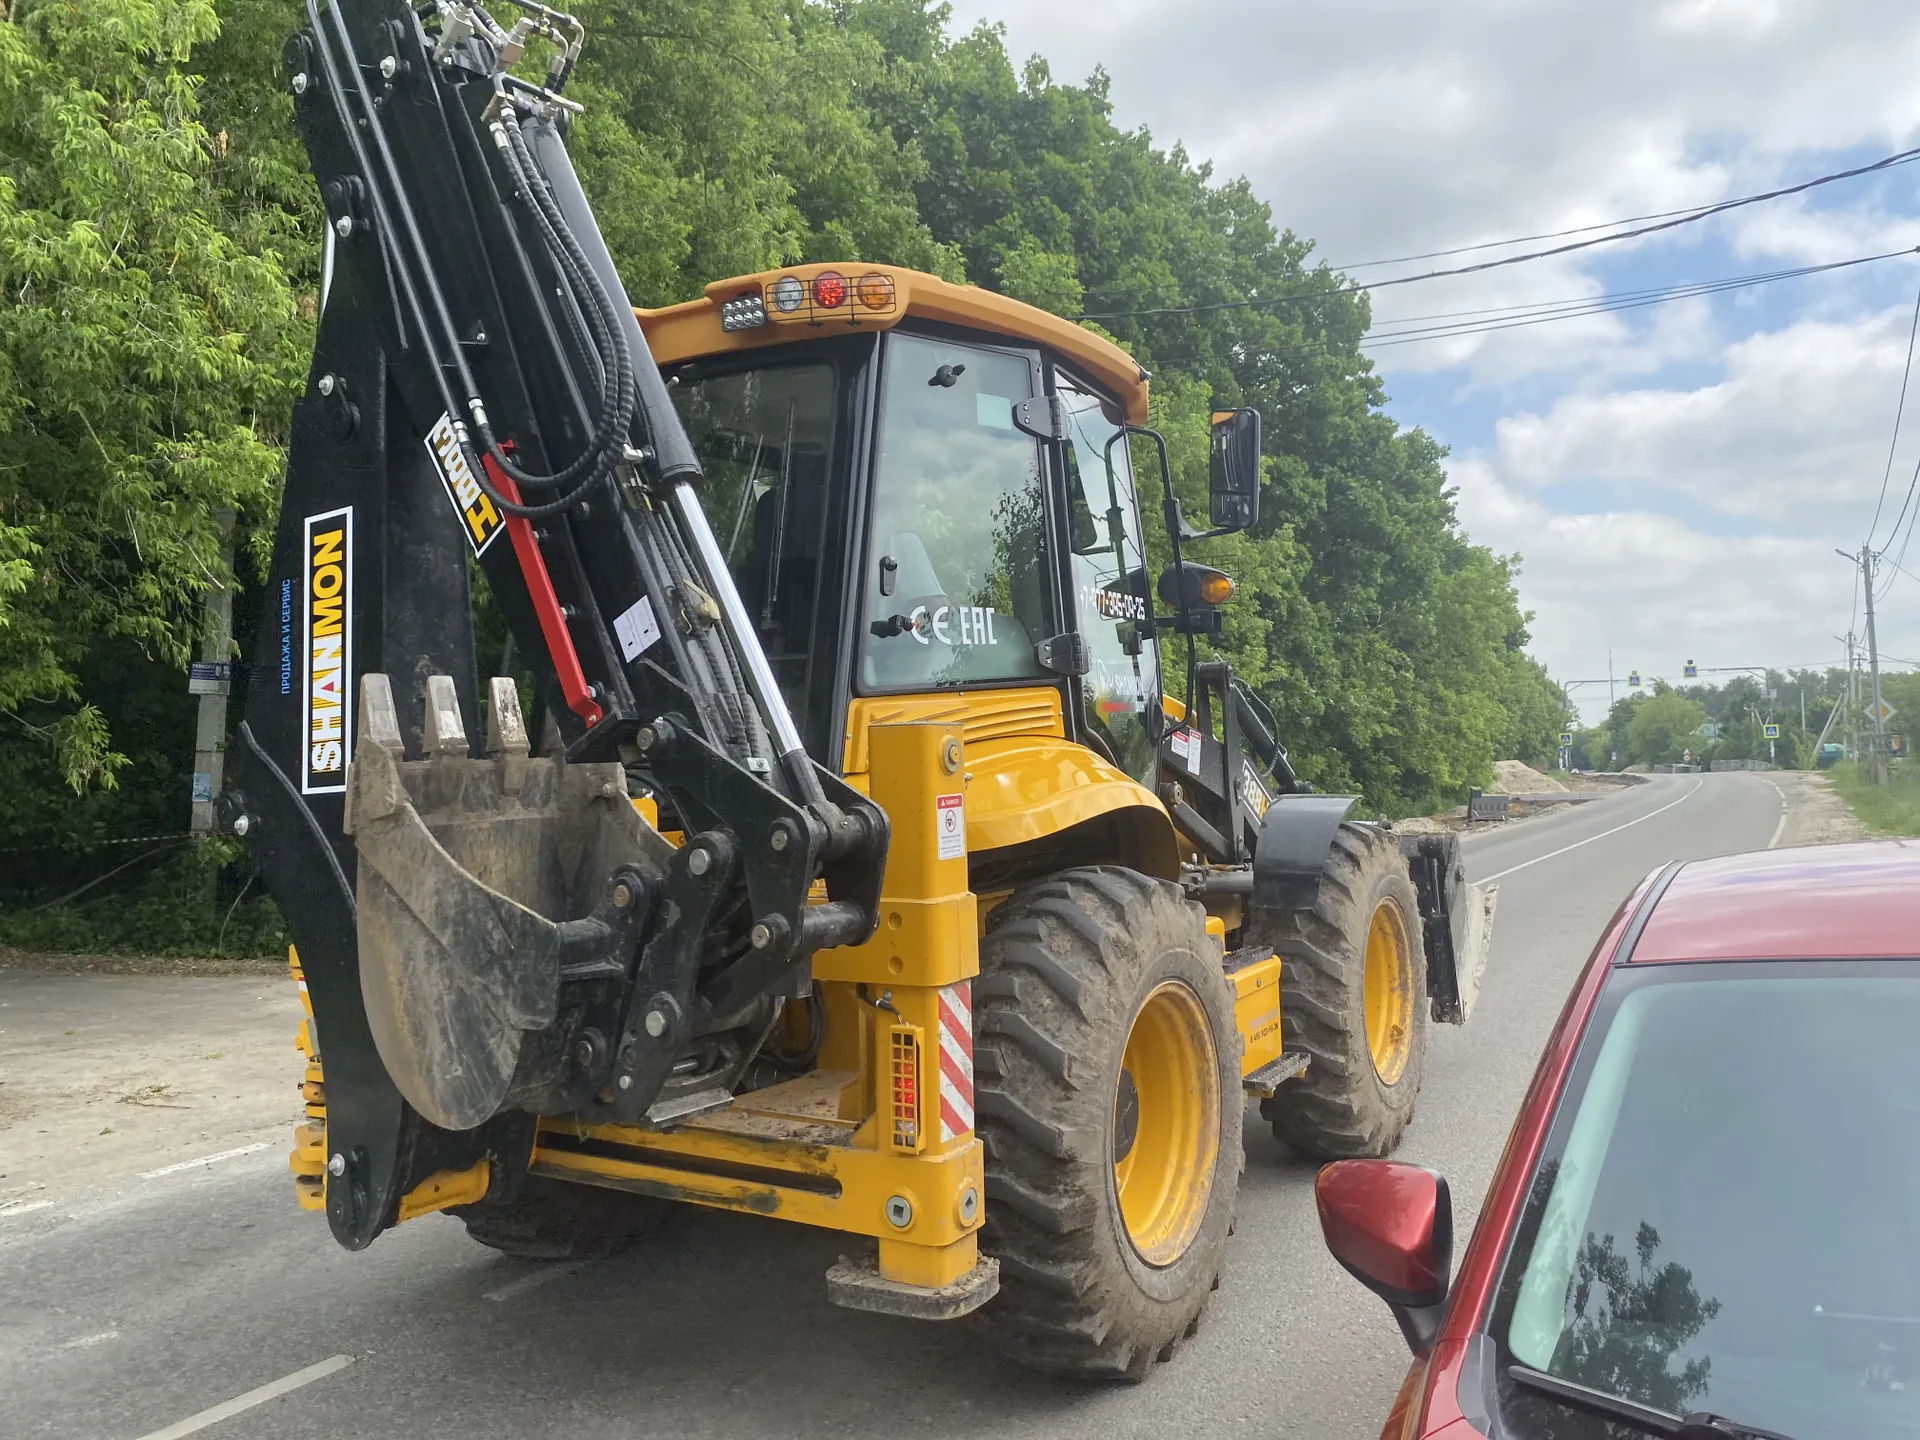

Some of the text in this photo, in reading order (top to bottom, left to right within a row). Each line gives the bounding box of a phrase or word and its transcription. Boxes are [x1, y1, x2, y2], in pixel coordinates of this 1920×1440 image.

[432, 415, 499, 544] 388H
[281, 578, 292, 695] ПРОДАЖА И СЕРВИС
[311, 529, 343, 773] SHANMON
